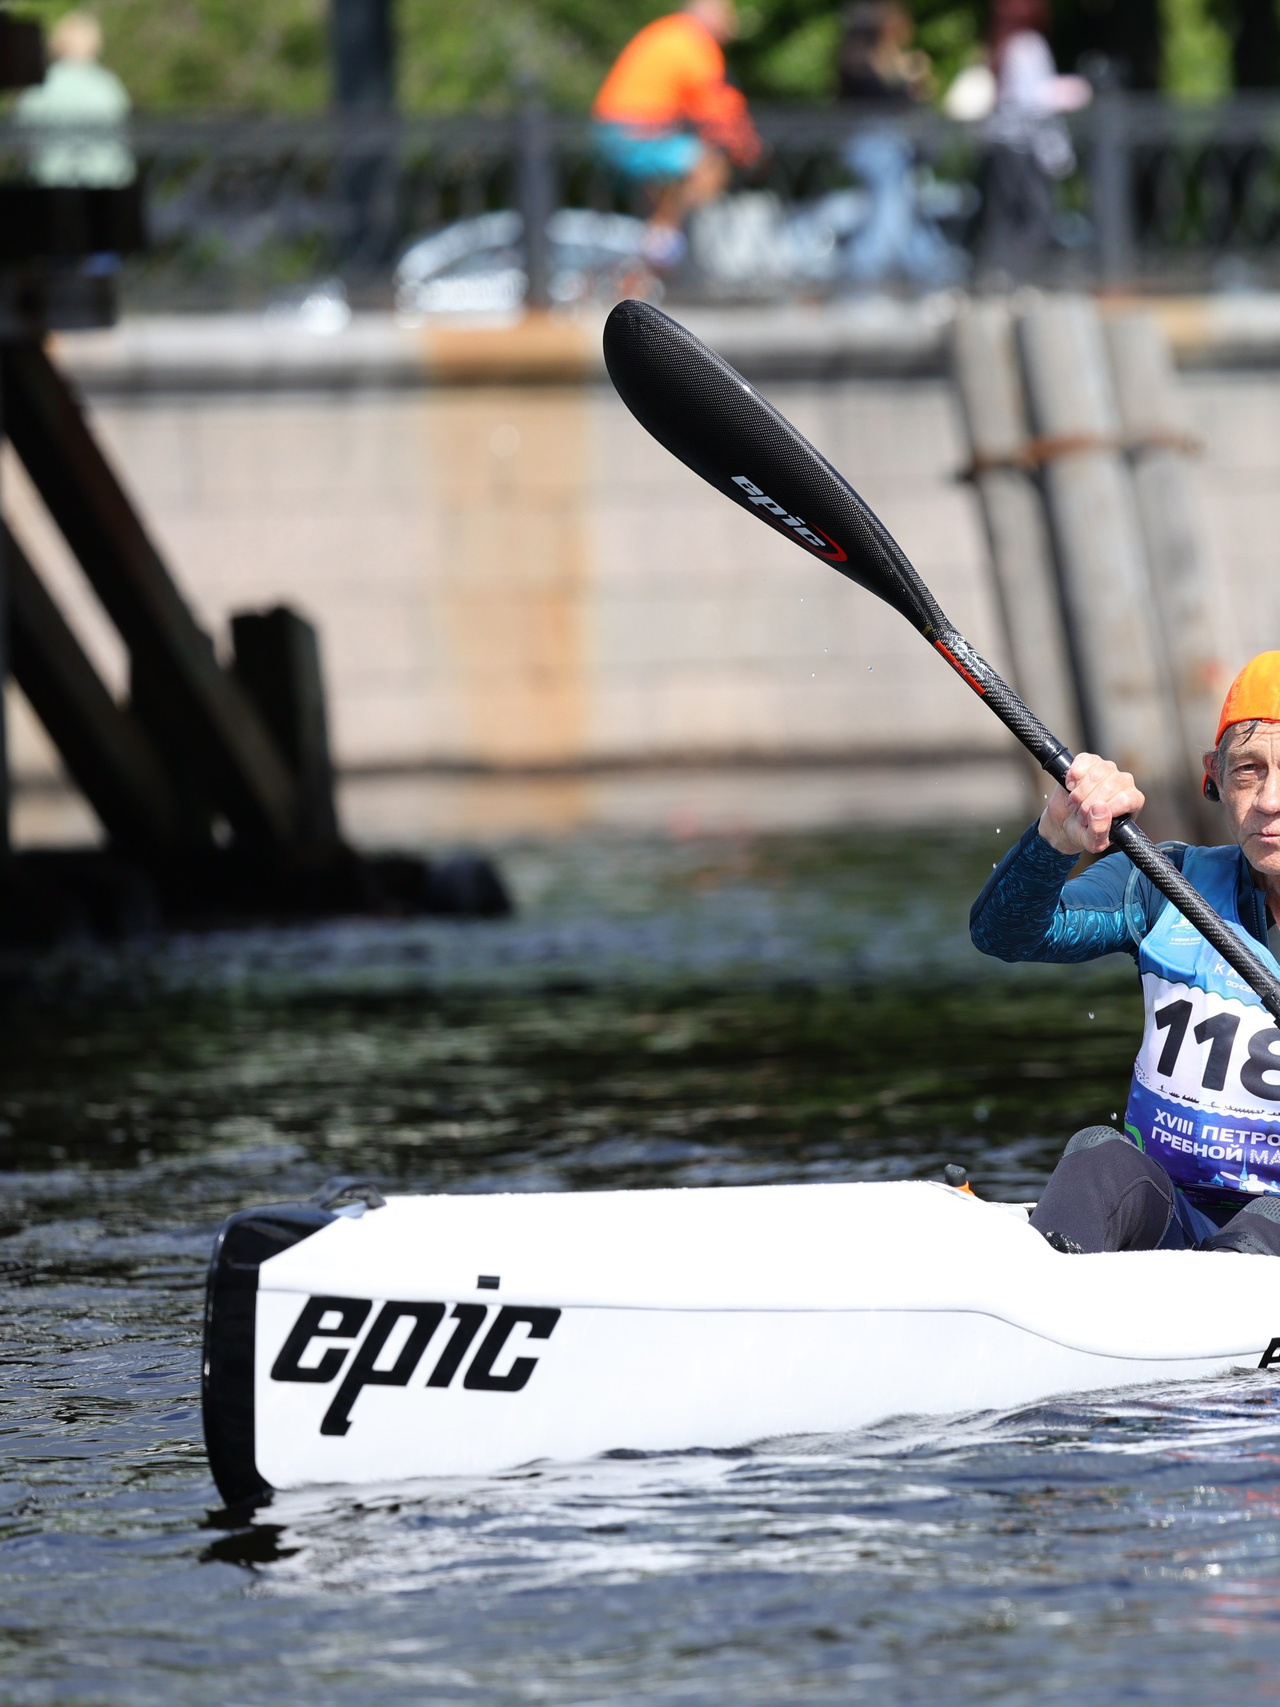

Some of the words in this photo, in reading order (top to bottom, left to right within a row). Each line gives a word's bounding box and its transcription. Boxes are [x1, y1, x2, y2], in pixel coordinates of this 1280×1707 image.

[731, 475, 826, 547] epic
[1151, 1125, 1243, 1162] ГРЕБНОЙ
[1154, 1107, 1194, 1136] XVIII
[270, 1275, 562, 1437] epic
